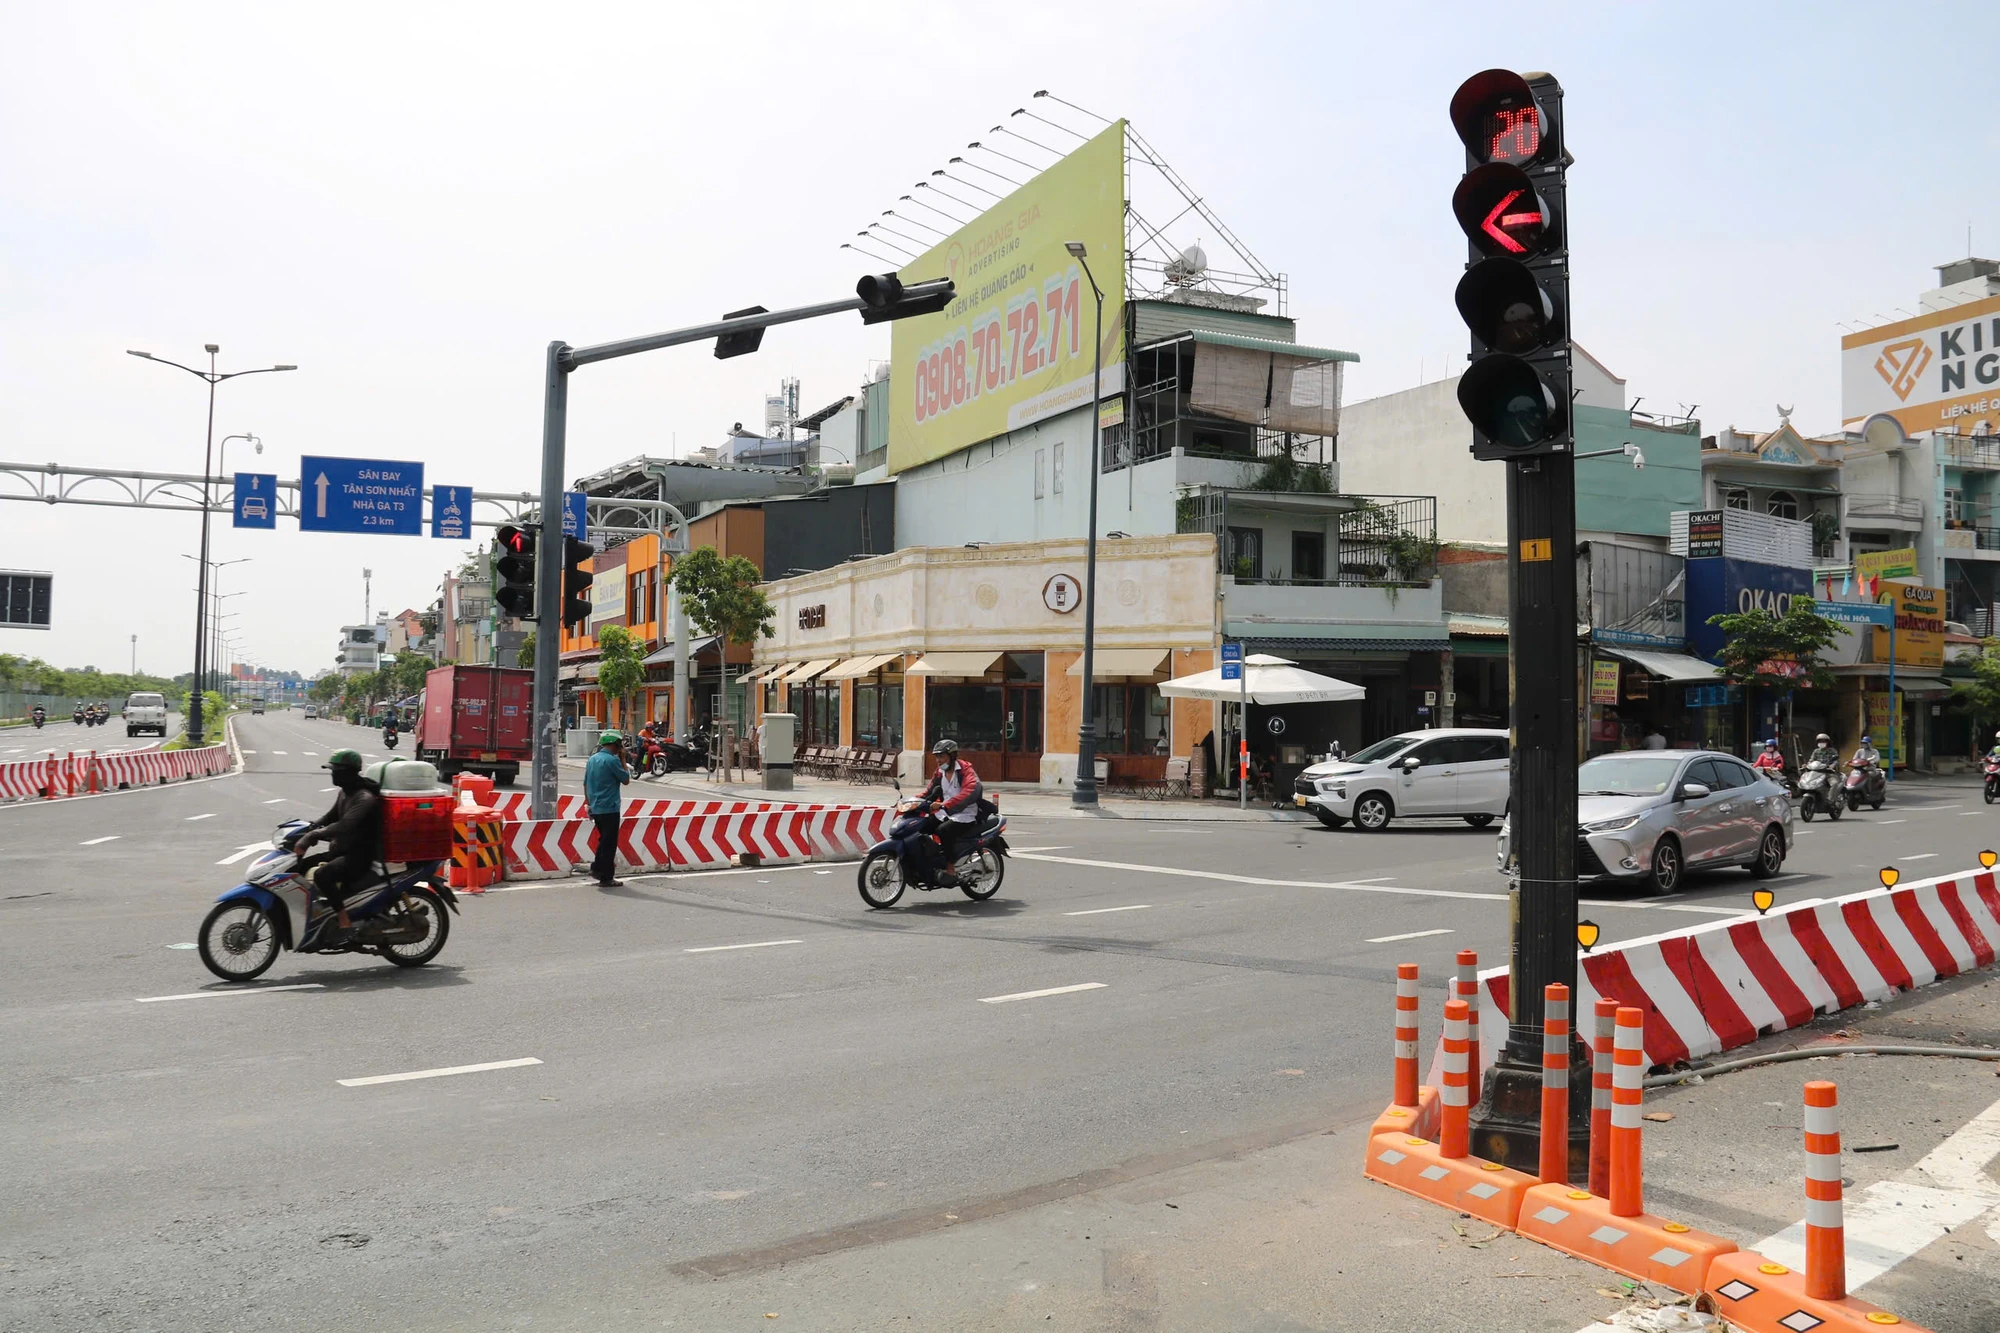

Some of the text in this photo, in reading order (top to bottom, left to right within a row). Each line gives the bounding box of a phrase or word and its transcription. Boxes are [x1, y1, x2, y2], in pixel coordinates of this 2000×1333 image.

[1492, 106, 1539, 159] 20
[968, 237, 1020, 277] ADVERTISING
[914, 277, 1080, 423] 0908.70.72.71
[1970, 397, 1988, 414] HỆ
[358, 468, 401, 481] SÂN BAY
[342, 482, 417, 497] TÂN SƠN NHẤT
[353, 498, 405, 511] NHÀ GA T3
[362, 515, 395, 526] 2.3 km
[1690, 513, 1721, 523] OKACHI
